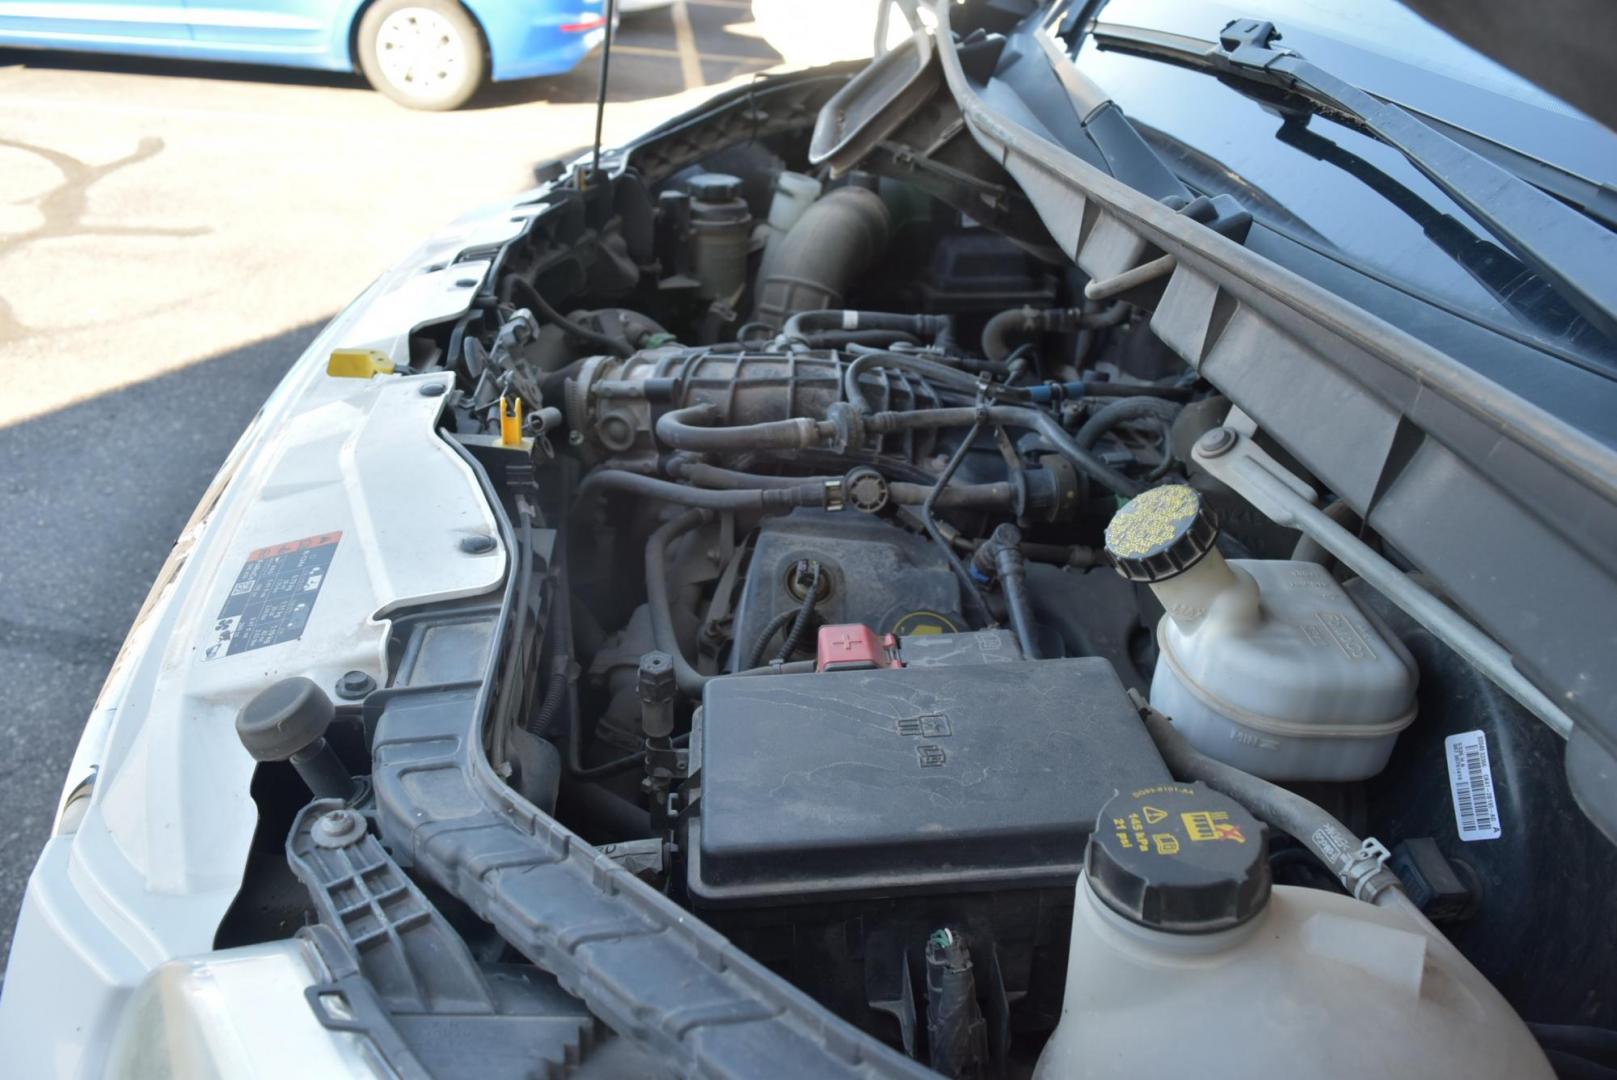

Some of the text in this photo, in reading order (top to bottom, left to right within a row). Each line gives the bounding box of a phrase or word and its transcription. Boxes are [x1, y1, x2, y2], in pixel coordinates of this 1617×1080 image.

[1113, 817, 1133, 848] 21 psi
[1129, 813, 1149, 852] 145 kPa
